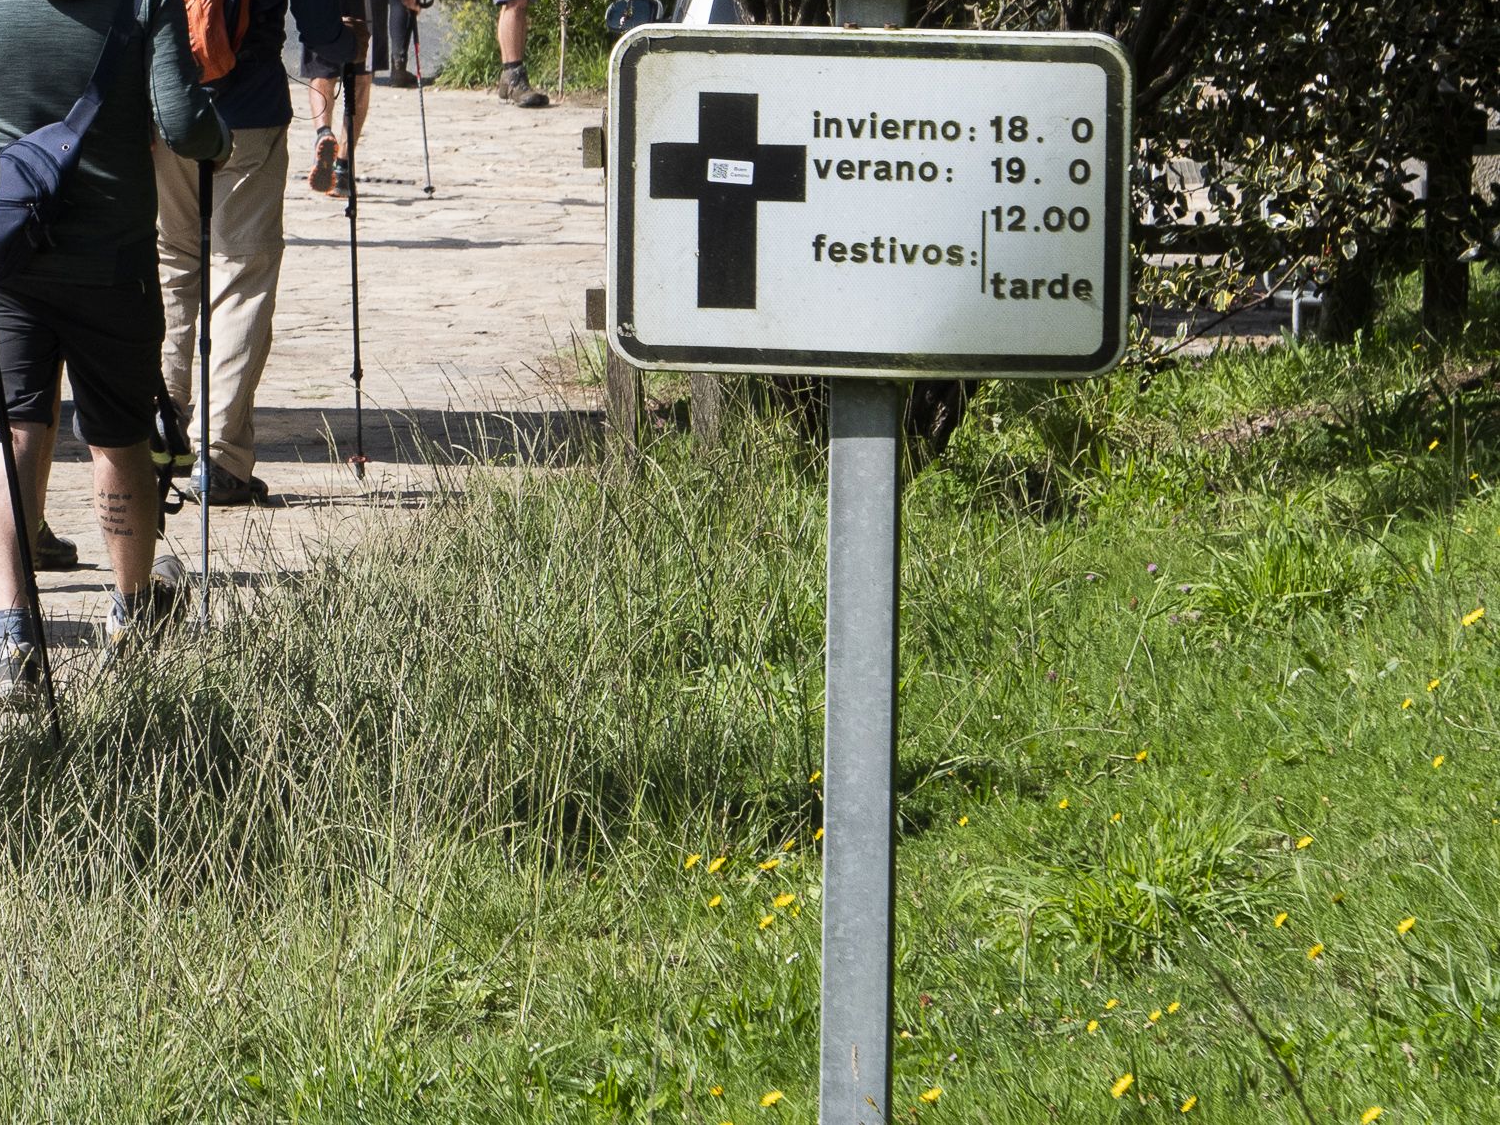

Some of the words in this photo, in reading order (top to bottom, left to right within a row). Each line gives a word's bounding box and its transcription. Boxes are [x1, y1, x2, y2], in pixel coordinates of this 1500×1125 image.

[812, 110, 976, 142] invierno:
[812, 158, 954, 184] verano:
[989, 205, 1092, 233] 12.00
[811, 233, 978, 267] festivos:
[989, 272, 1096, 305] tarde
